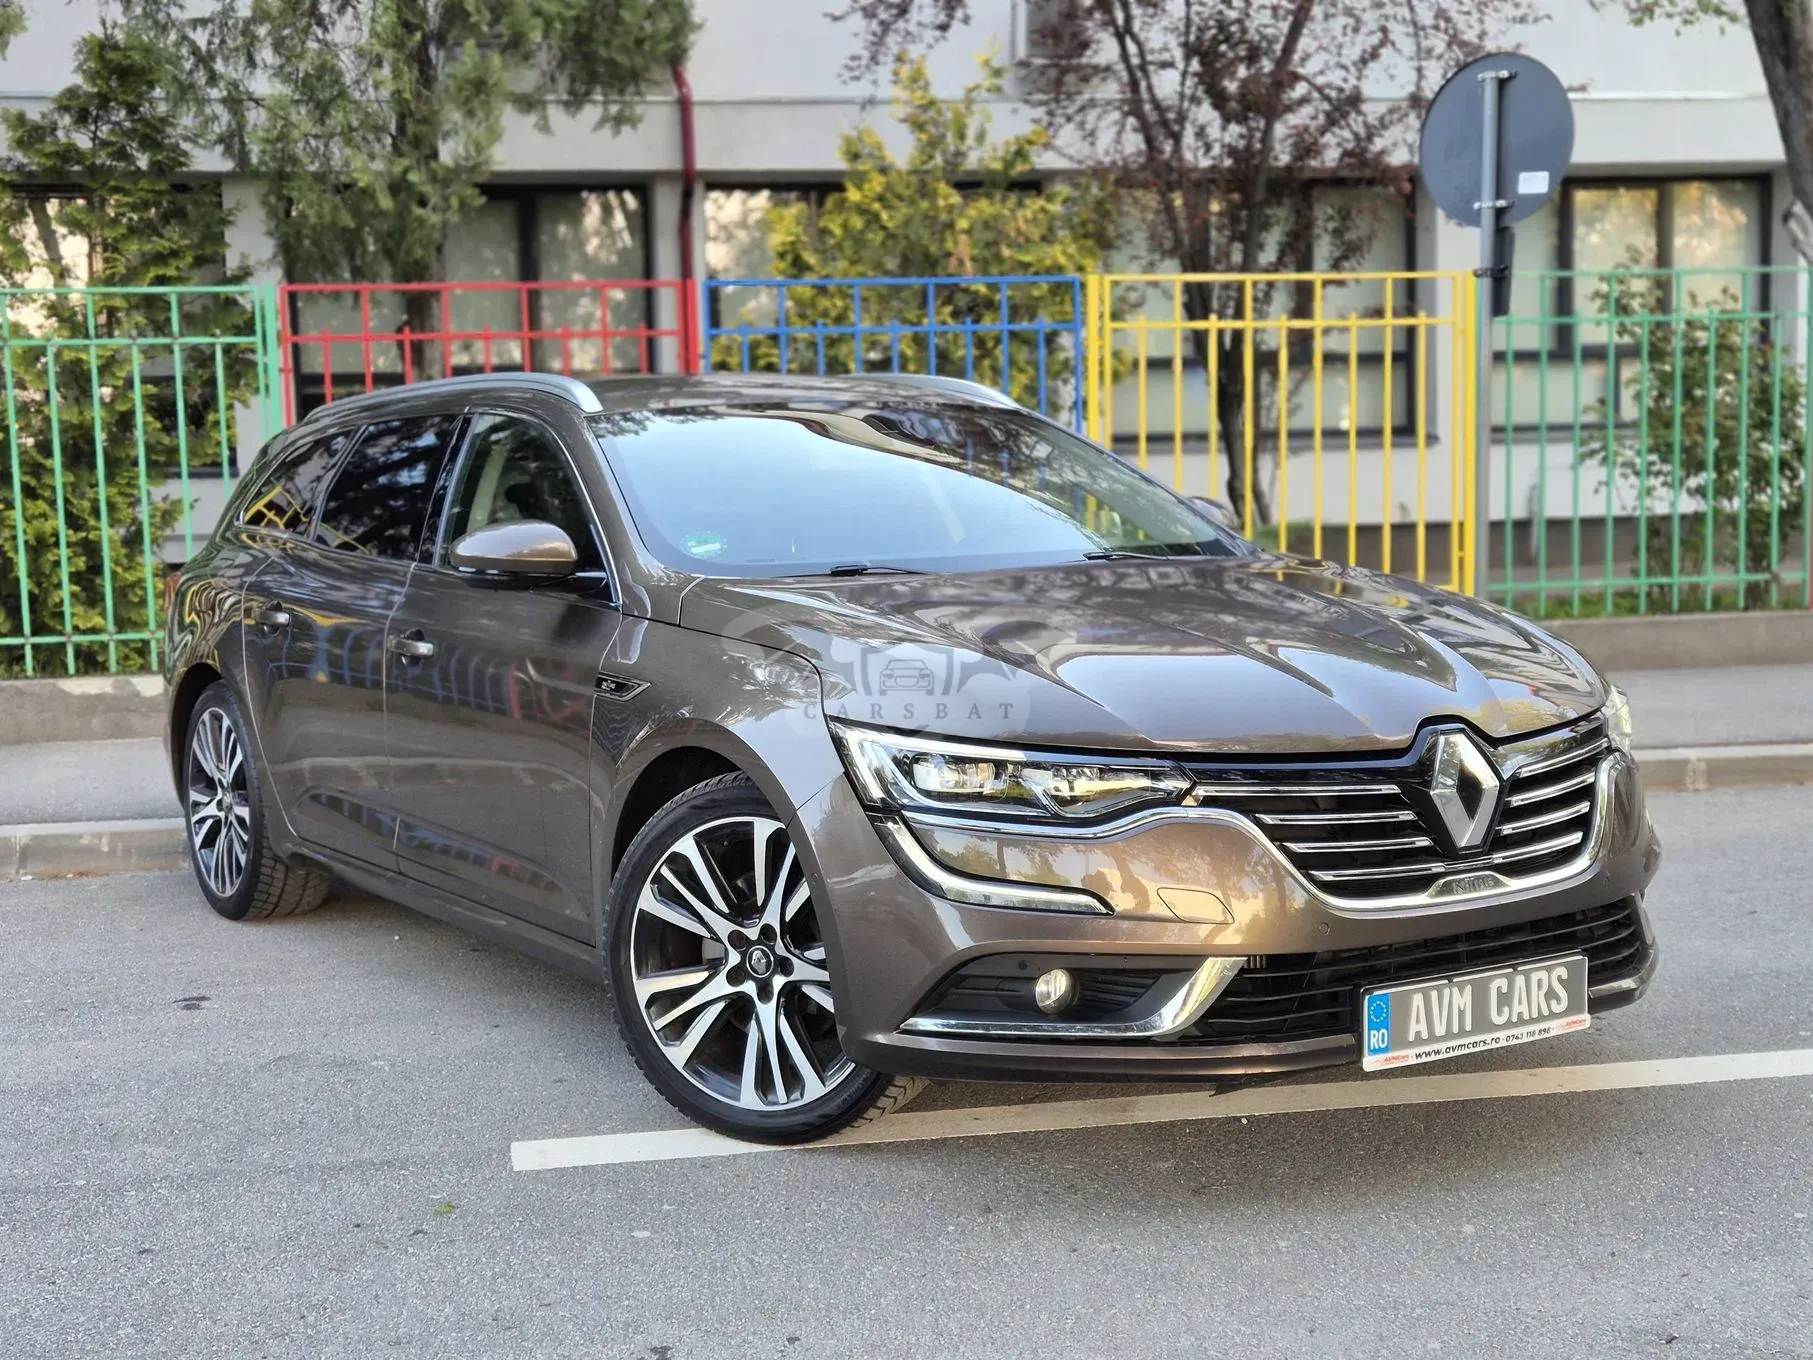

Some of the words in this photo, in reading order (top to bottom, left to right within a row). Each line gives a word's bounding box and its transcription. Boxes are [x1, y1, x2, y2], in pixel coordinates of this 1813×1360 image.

[1408, 983, 1473, 1042] AVM
[1488, 966, 1569, 1026] CARS
[1370, 1028, 1388, 1050] RO
[1414, 1035, 1501, 1061] www.avmcars.ro
[1505, 1032, 1525, 1043] 0743
[1526, 1029, 1537, 1039] 118
[1538, 1026, 1552, 1037] 898
